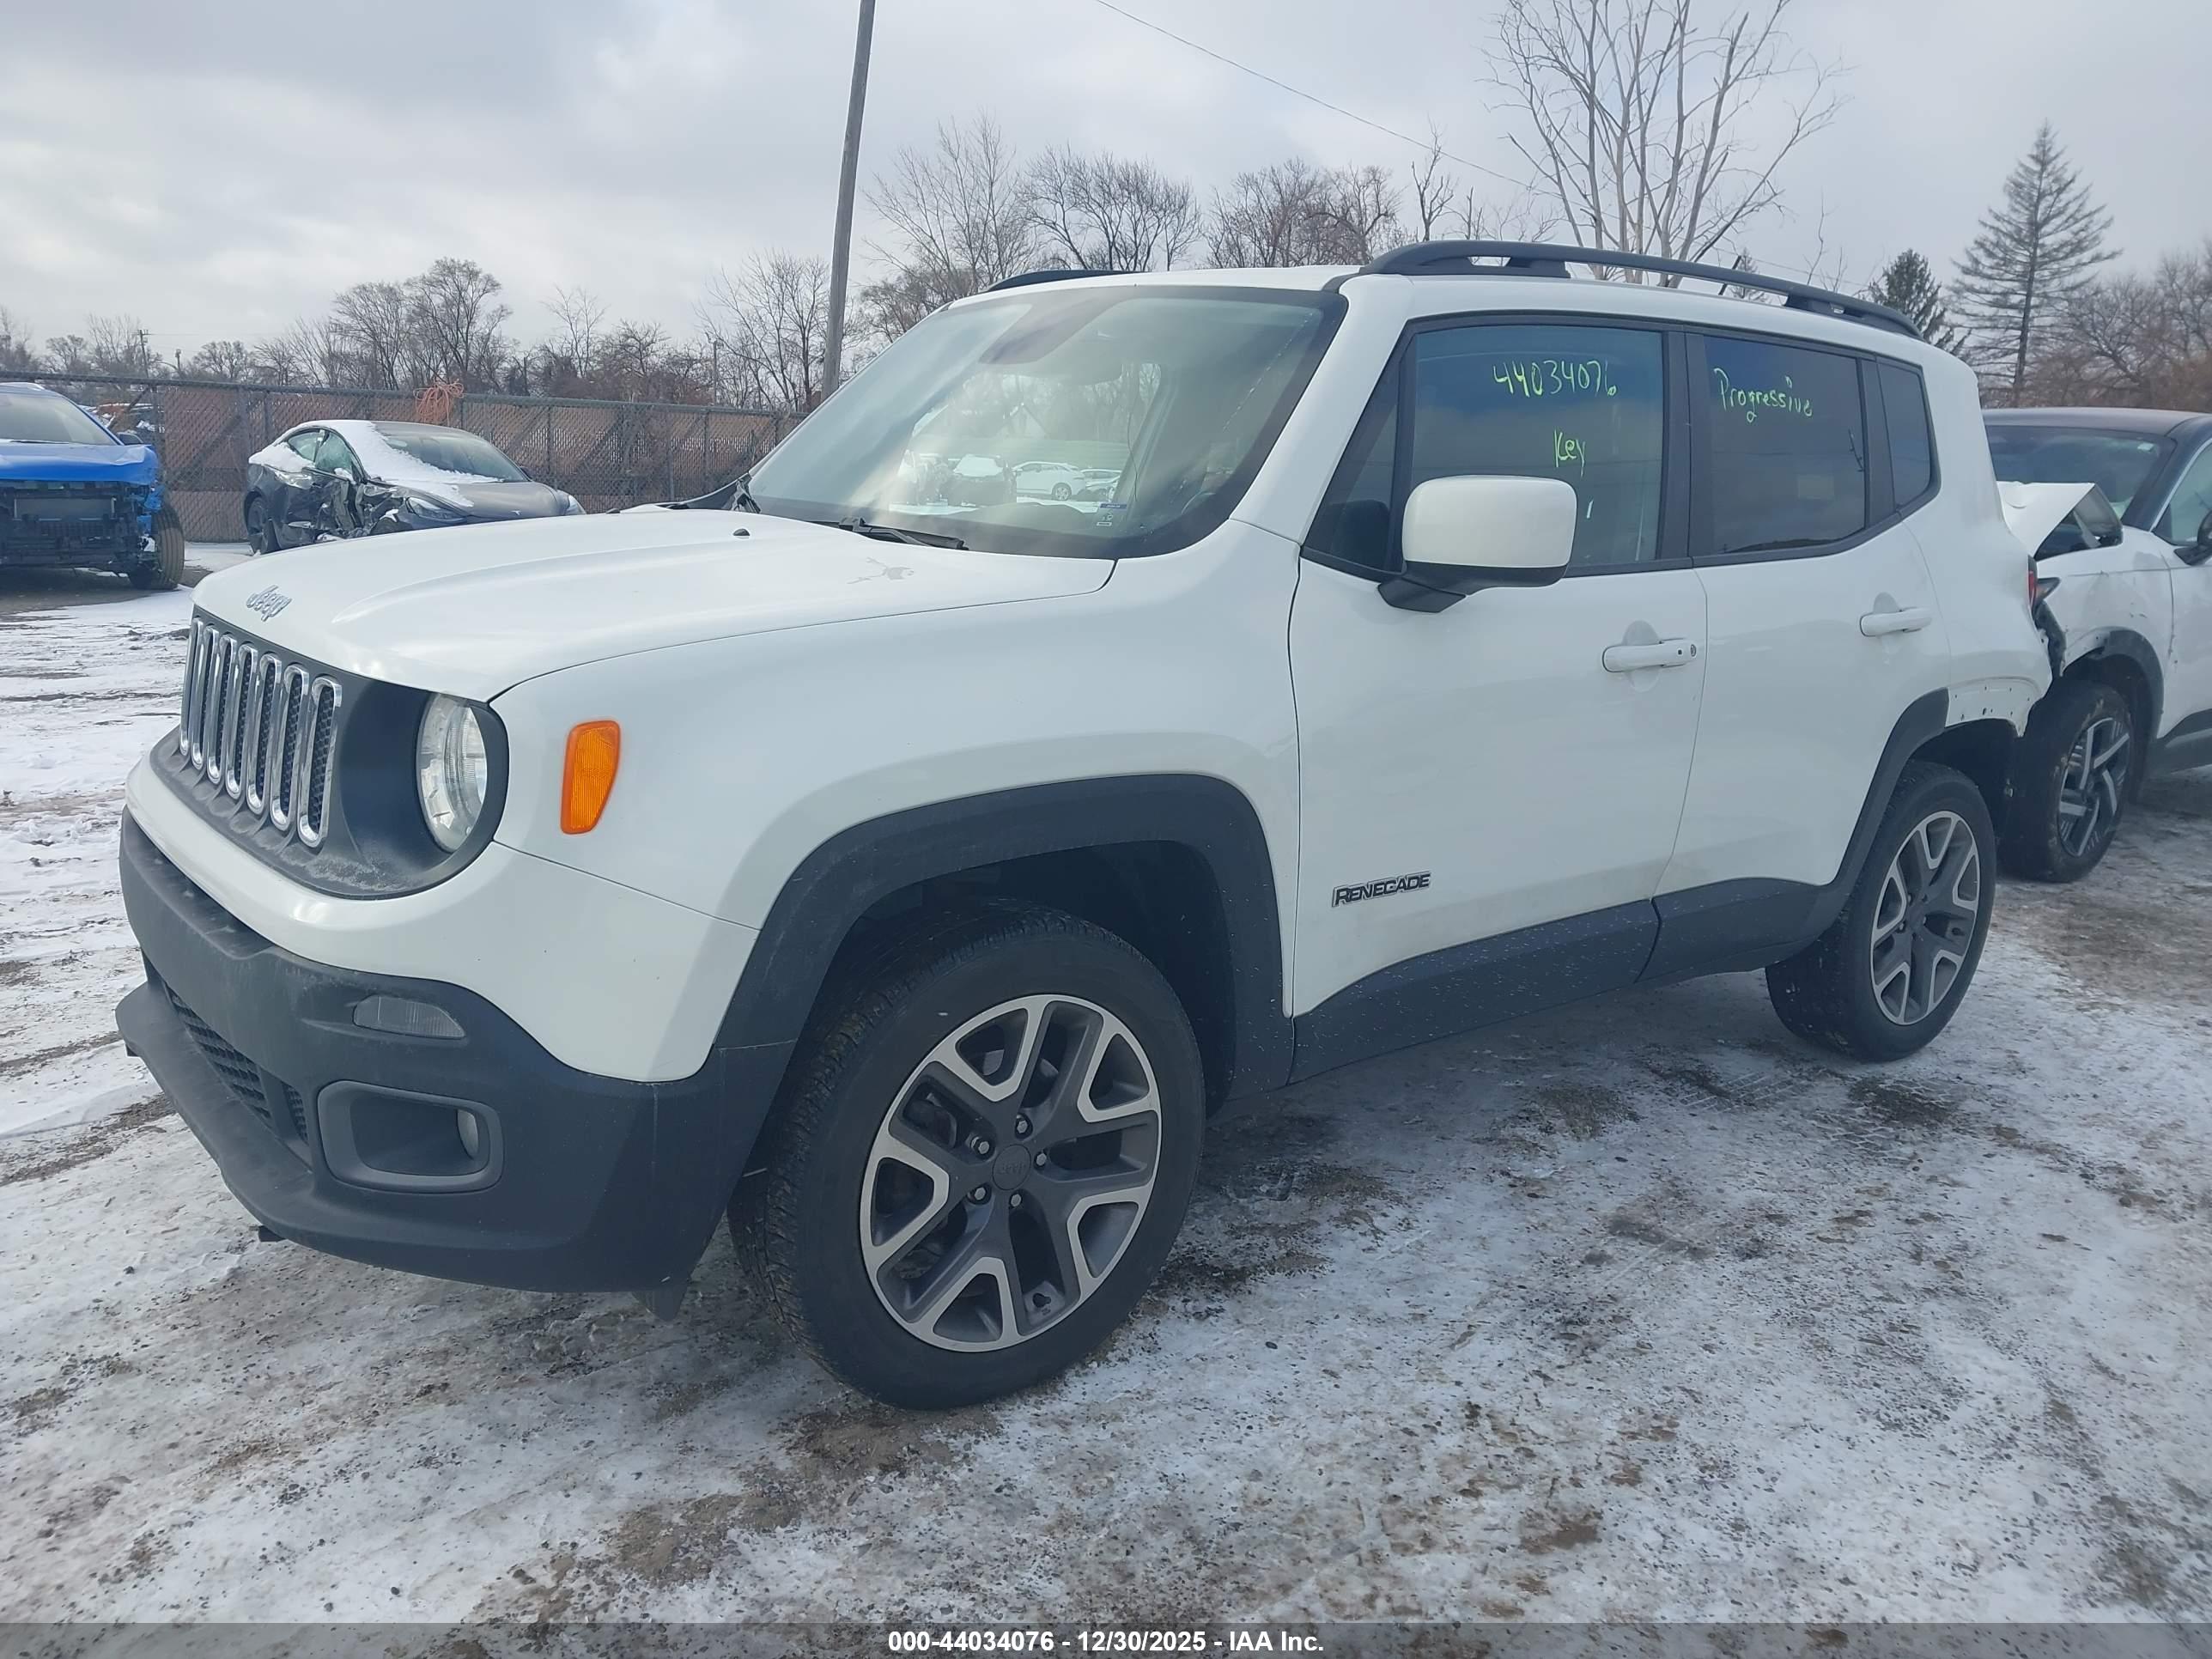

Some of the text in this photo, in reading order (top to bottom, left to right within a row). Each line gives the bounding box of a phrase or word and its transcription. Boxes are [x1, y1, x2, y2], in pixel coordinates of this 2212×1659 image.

[1492, 360, 1617, 398] 44034076
[1713, 368, 1813, 423] Progressive
[1553, 429, 1587, 477] Key
[246, 585, 293, 622] Jeep
[1332, 871, 1431, 908] RENEGADE
